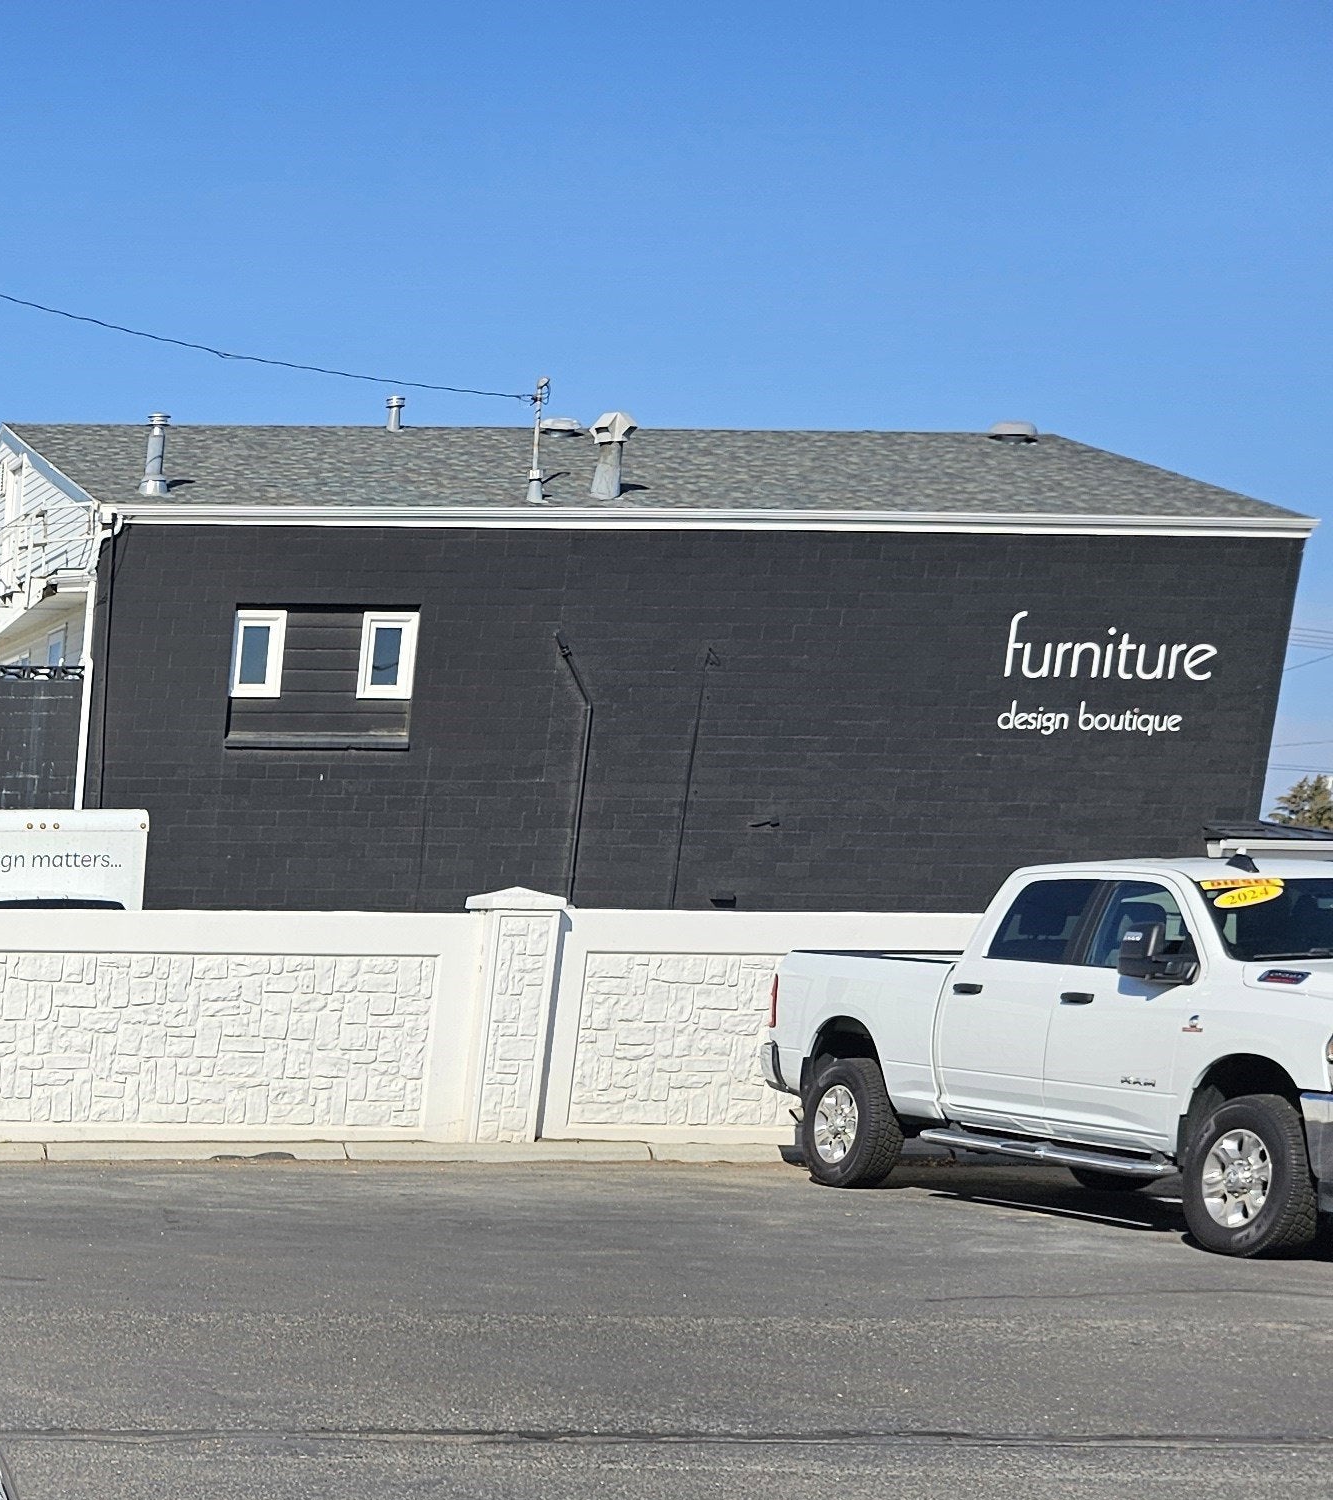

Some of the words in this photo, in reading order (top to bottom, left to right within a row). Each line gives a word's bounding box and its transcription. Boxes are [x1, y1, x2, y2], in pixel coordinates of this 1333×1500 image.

[1003, 610, 1218, 681] furniture
[996, 699, 1069, 736] design
[1078, 700, 1183, 737] boutique
[31, 851, 123, 869] matters...
[1228, 886, 1269, 905] 2024
